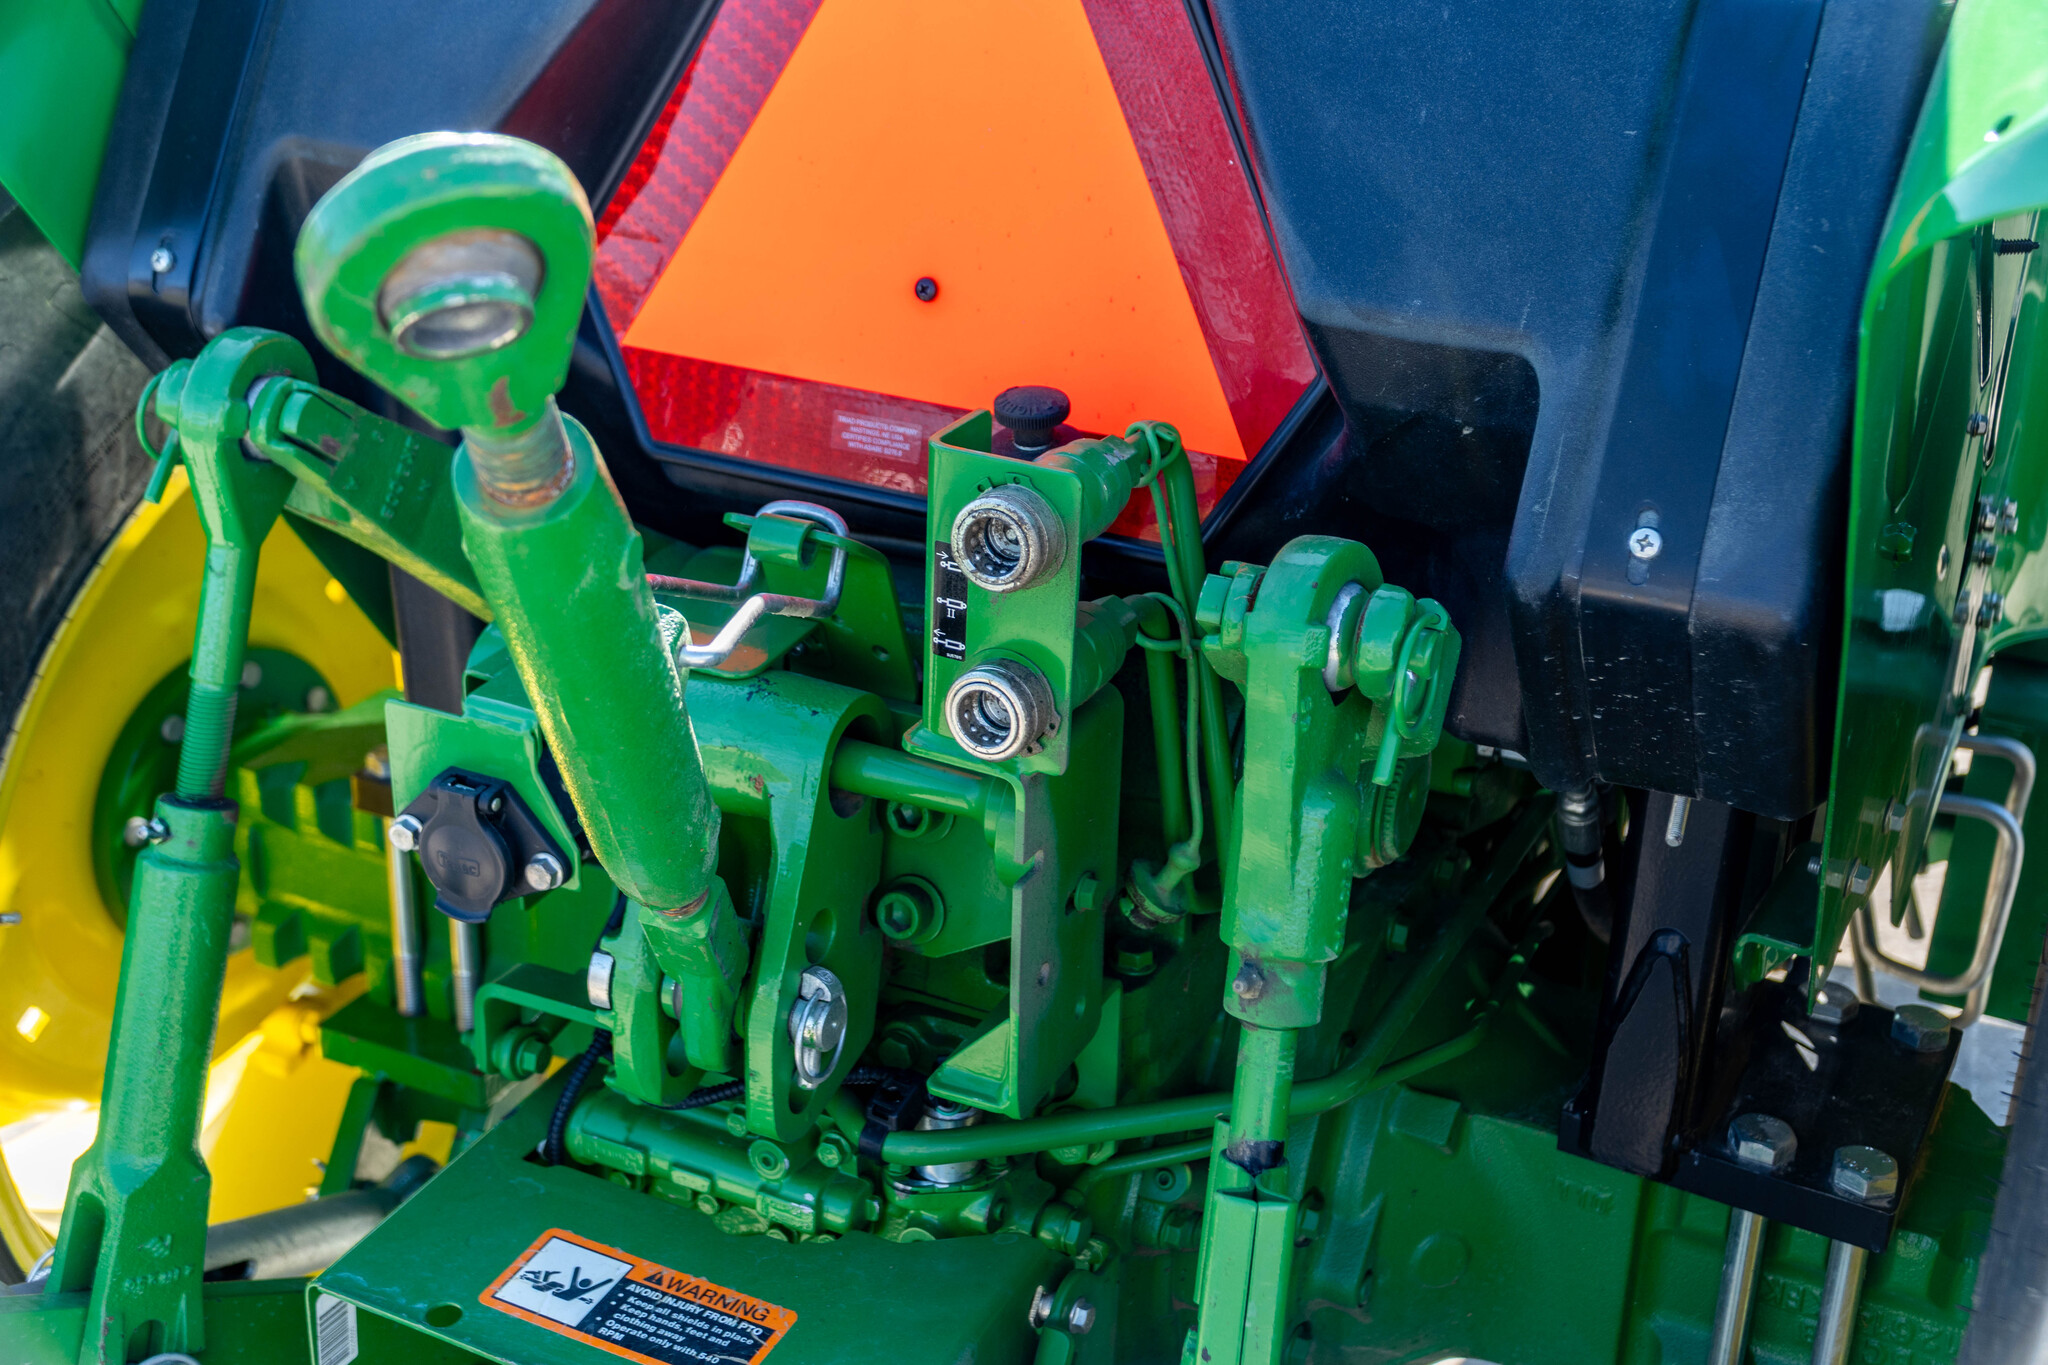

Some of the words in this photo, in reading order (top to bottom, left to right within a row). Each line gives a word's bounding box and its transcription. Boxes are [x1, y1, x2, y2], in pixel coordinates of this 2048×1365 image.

[856, 418, 888, 430] PRODUCTS
[890, 425, 918, 435] COMPANY
[873, 438, 910, 450] COMPLIANCE
[625, 1284, 662, 1300] AVOID
[662, 1296, 704, 1314] INJURY
[702, 1310, 738, 1327] FROM
[738, 1321, 763, 1336] PTO
[667, 1276, 770, 1322] WARNING
[597, 1327, 625, 1342] RPM
[604, 1319, 648, 1340] Operate
[648, 1336, 672, 1348] only
[672, 1344, 697, 1356] with
[697, 1352, 720, 1364] 540
[613, 1313, 658, 1334] clothing
[657, 1328, 686, 1342] away
[620, 1304, 648, 1318] Keep
[648, 1314, 683, 1332] hands,
[685, 1326, 710, 1340] feet
[708, 1336, 730, 1346] and
[627, 1296, 654, 1311] Keep
[655, 1307, 672, 1316] all
[671, 1312, 710, 1330] shields
[710, 1325, 723, 1334] in
[722, 1331, 754, 1345] place
